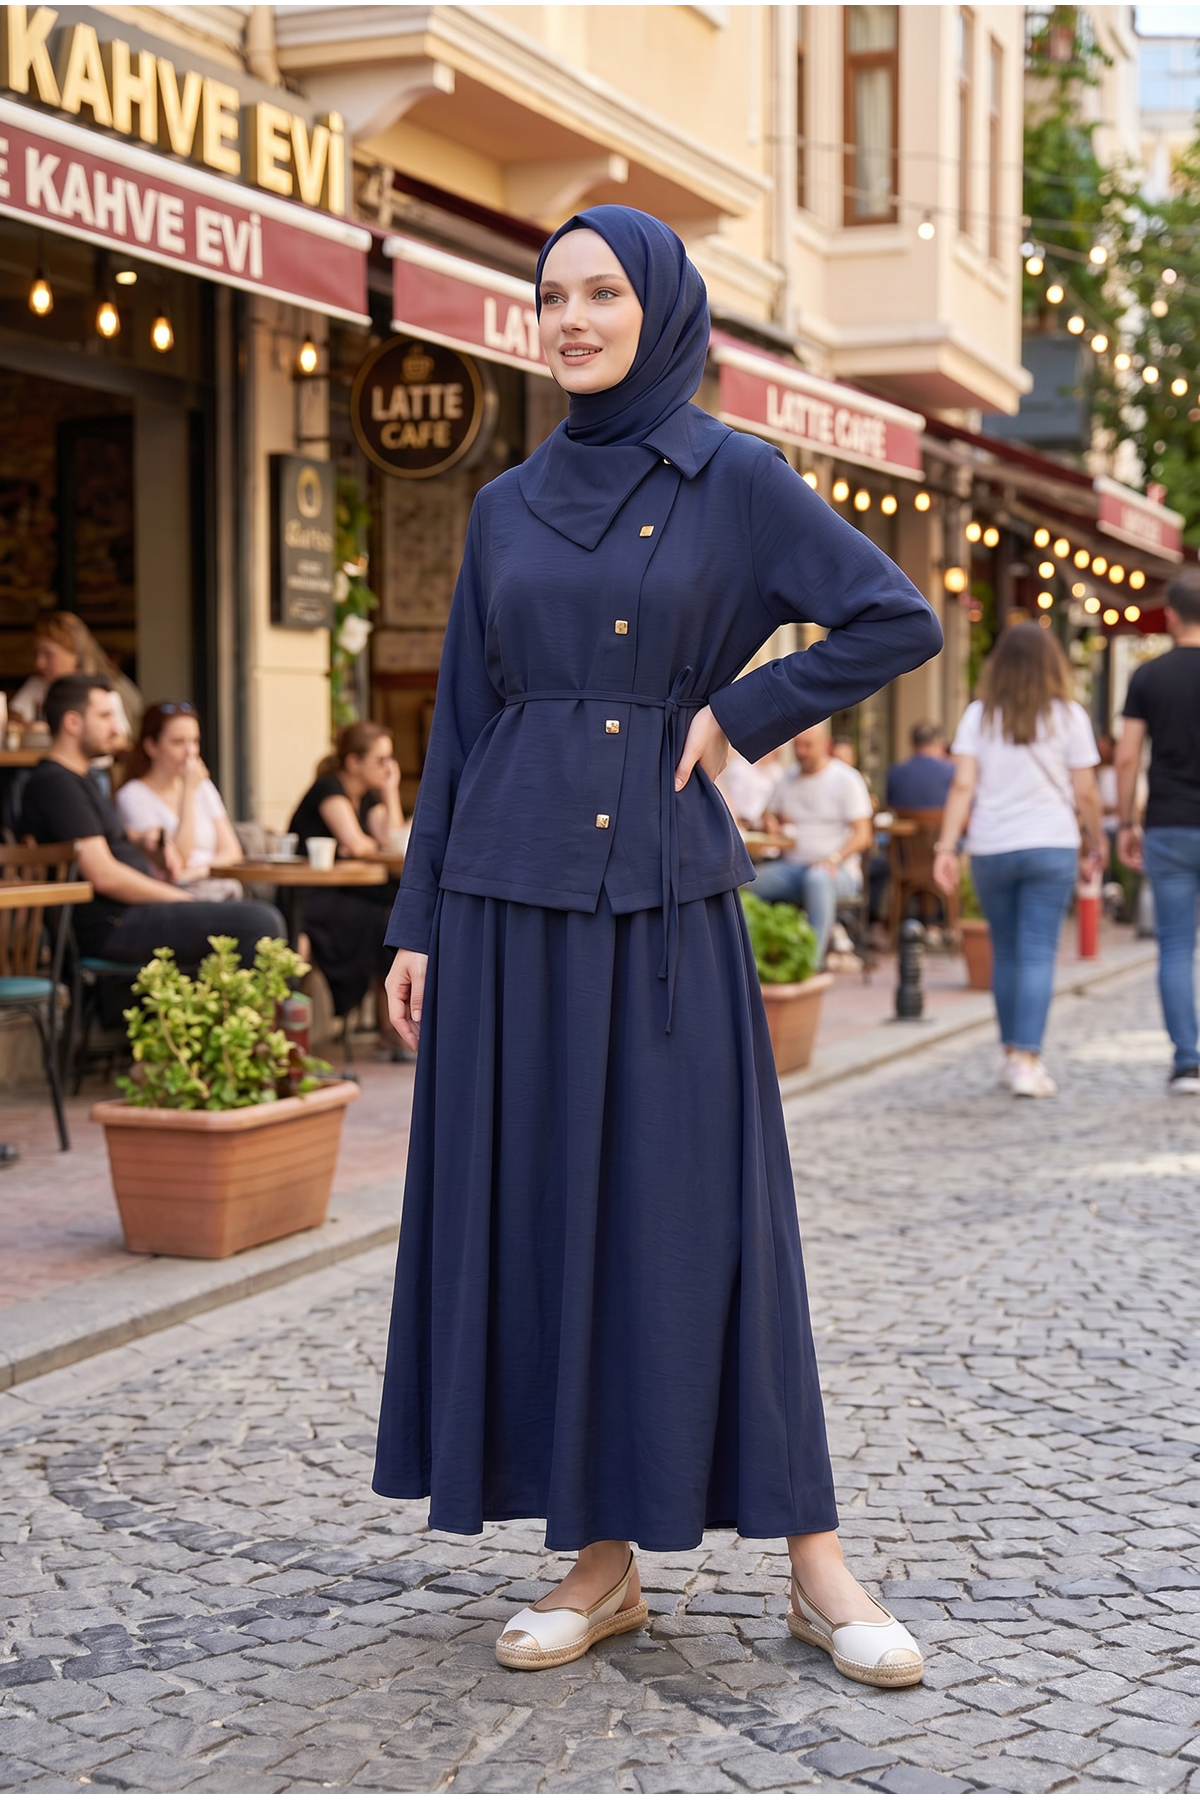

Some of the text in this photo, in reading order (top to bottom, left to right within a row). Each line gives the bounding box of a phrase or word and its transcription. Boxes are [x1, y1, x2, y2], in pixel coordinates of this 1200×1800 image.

[7, 5, 241, 176] KAHVE
[256, 101, 346, 215] EVİ
[25, 146, 187, 254] KAHVE
[195, 205, 264, 279] EVİ
[371, 383, 464, 421] LATTE
[766, 384, 835, 445] LATTE
[380, 421, 452, 450] CAFE
